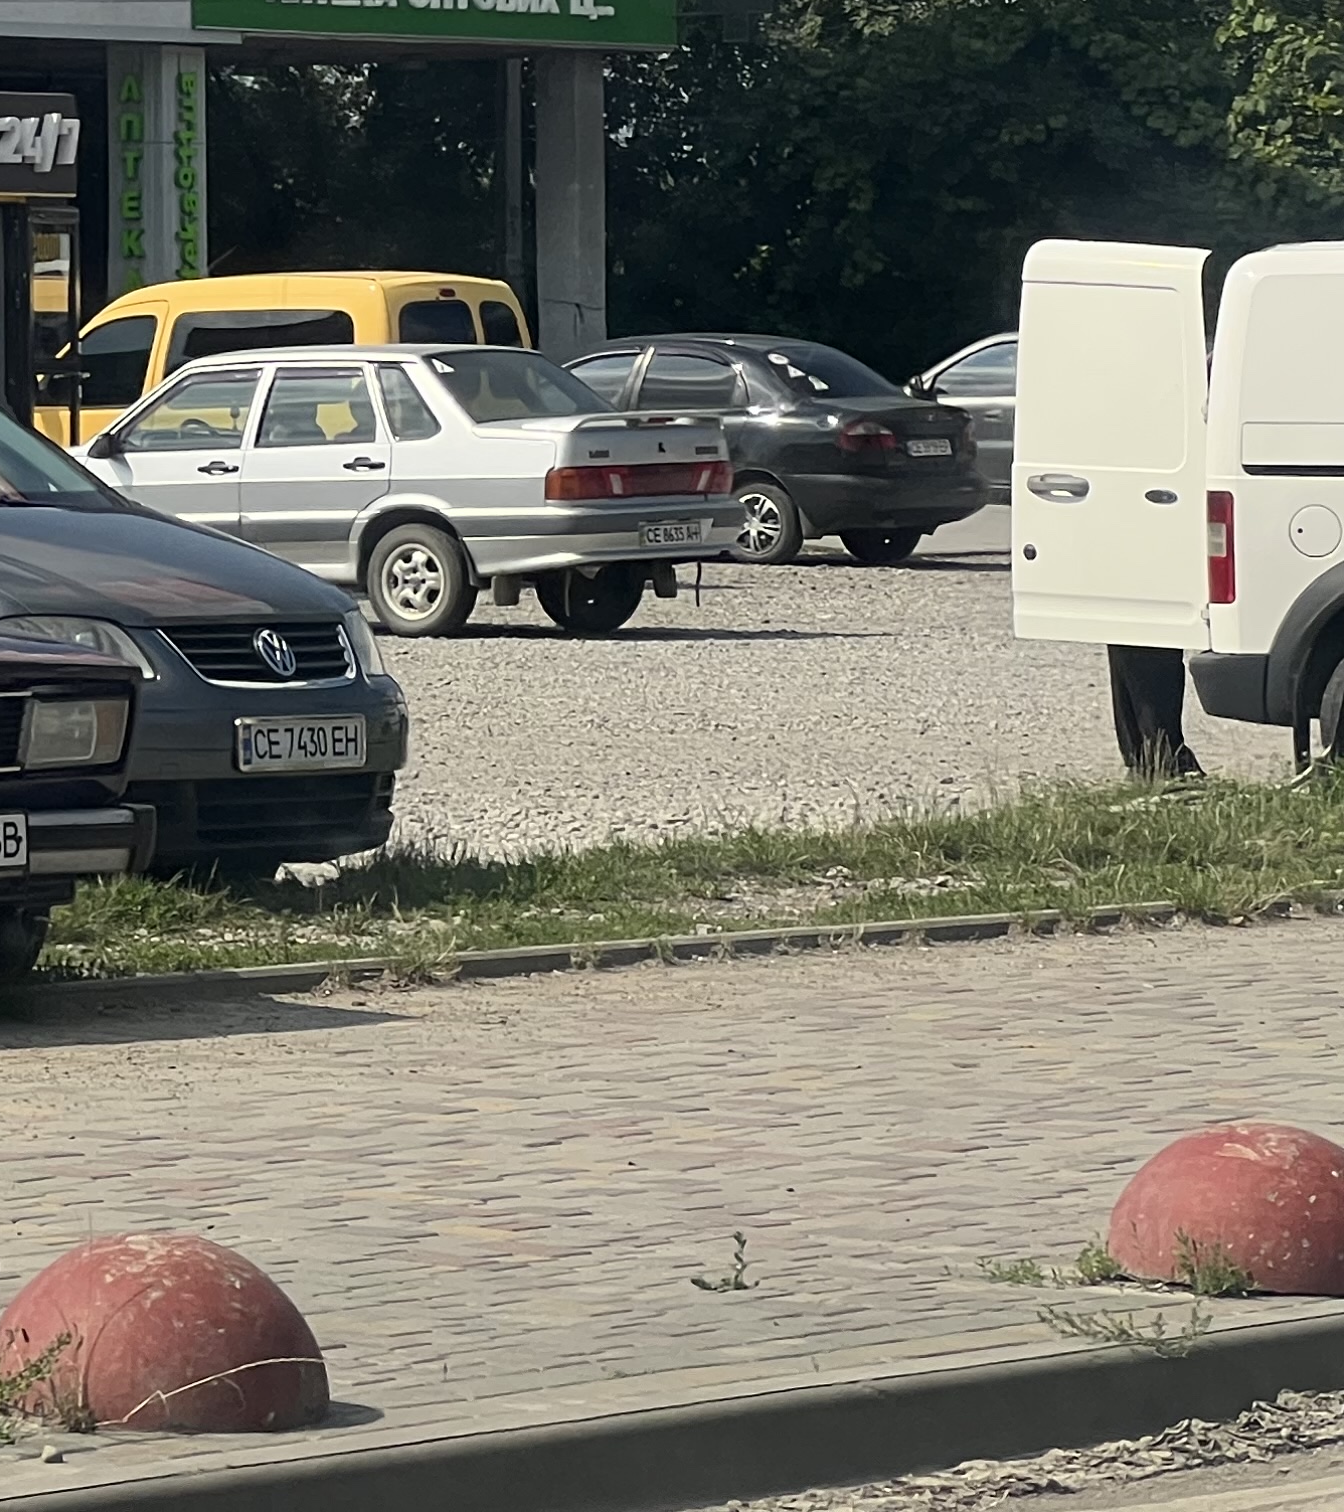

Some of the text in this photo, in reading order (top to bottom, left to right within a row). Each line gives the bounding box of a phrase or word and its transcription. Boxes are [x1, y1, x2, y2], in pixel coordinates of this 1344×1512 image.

[647, 528, 661, 543] CE
[254, 725, 358, 759] CE 7430 EH
